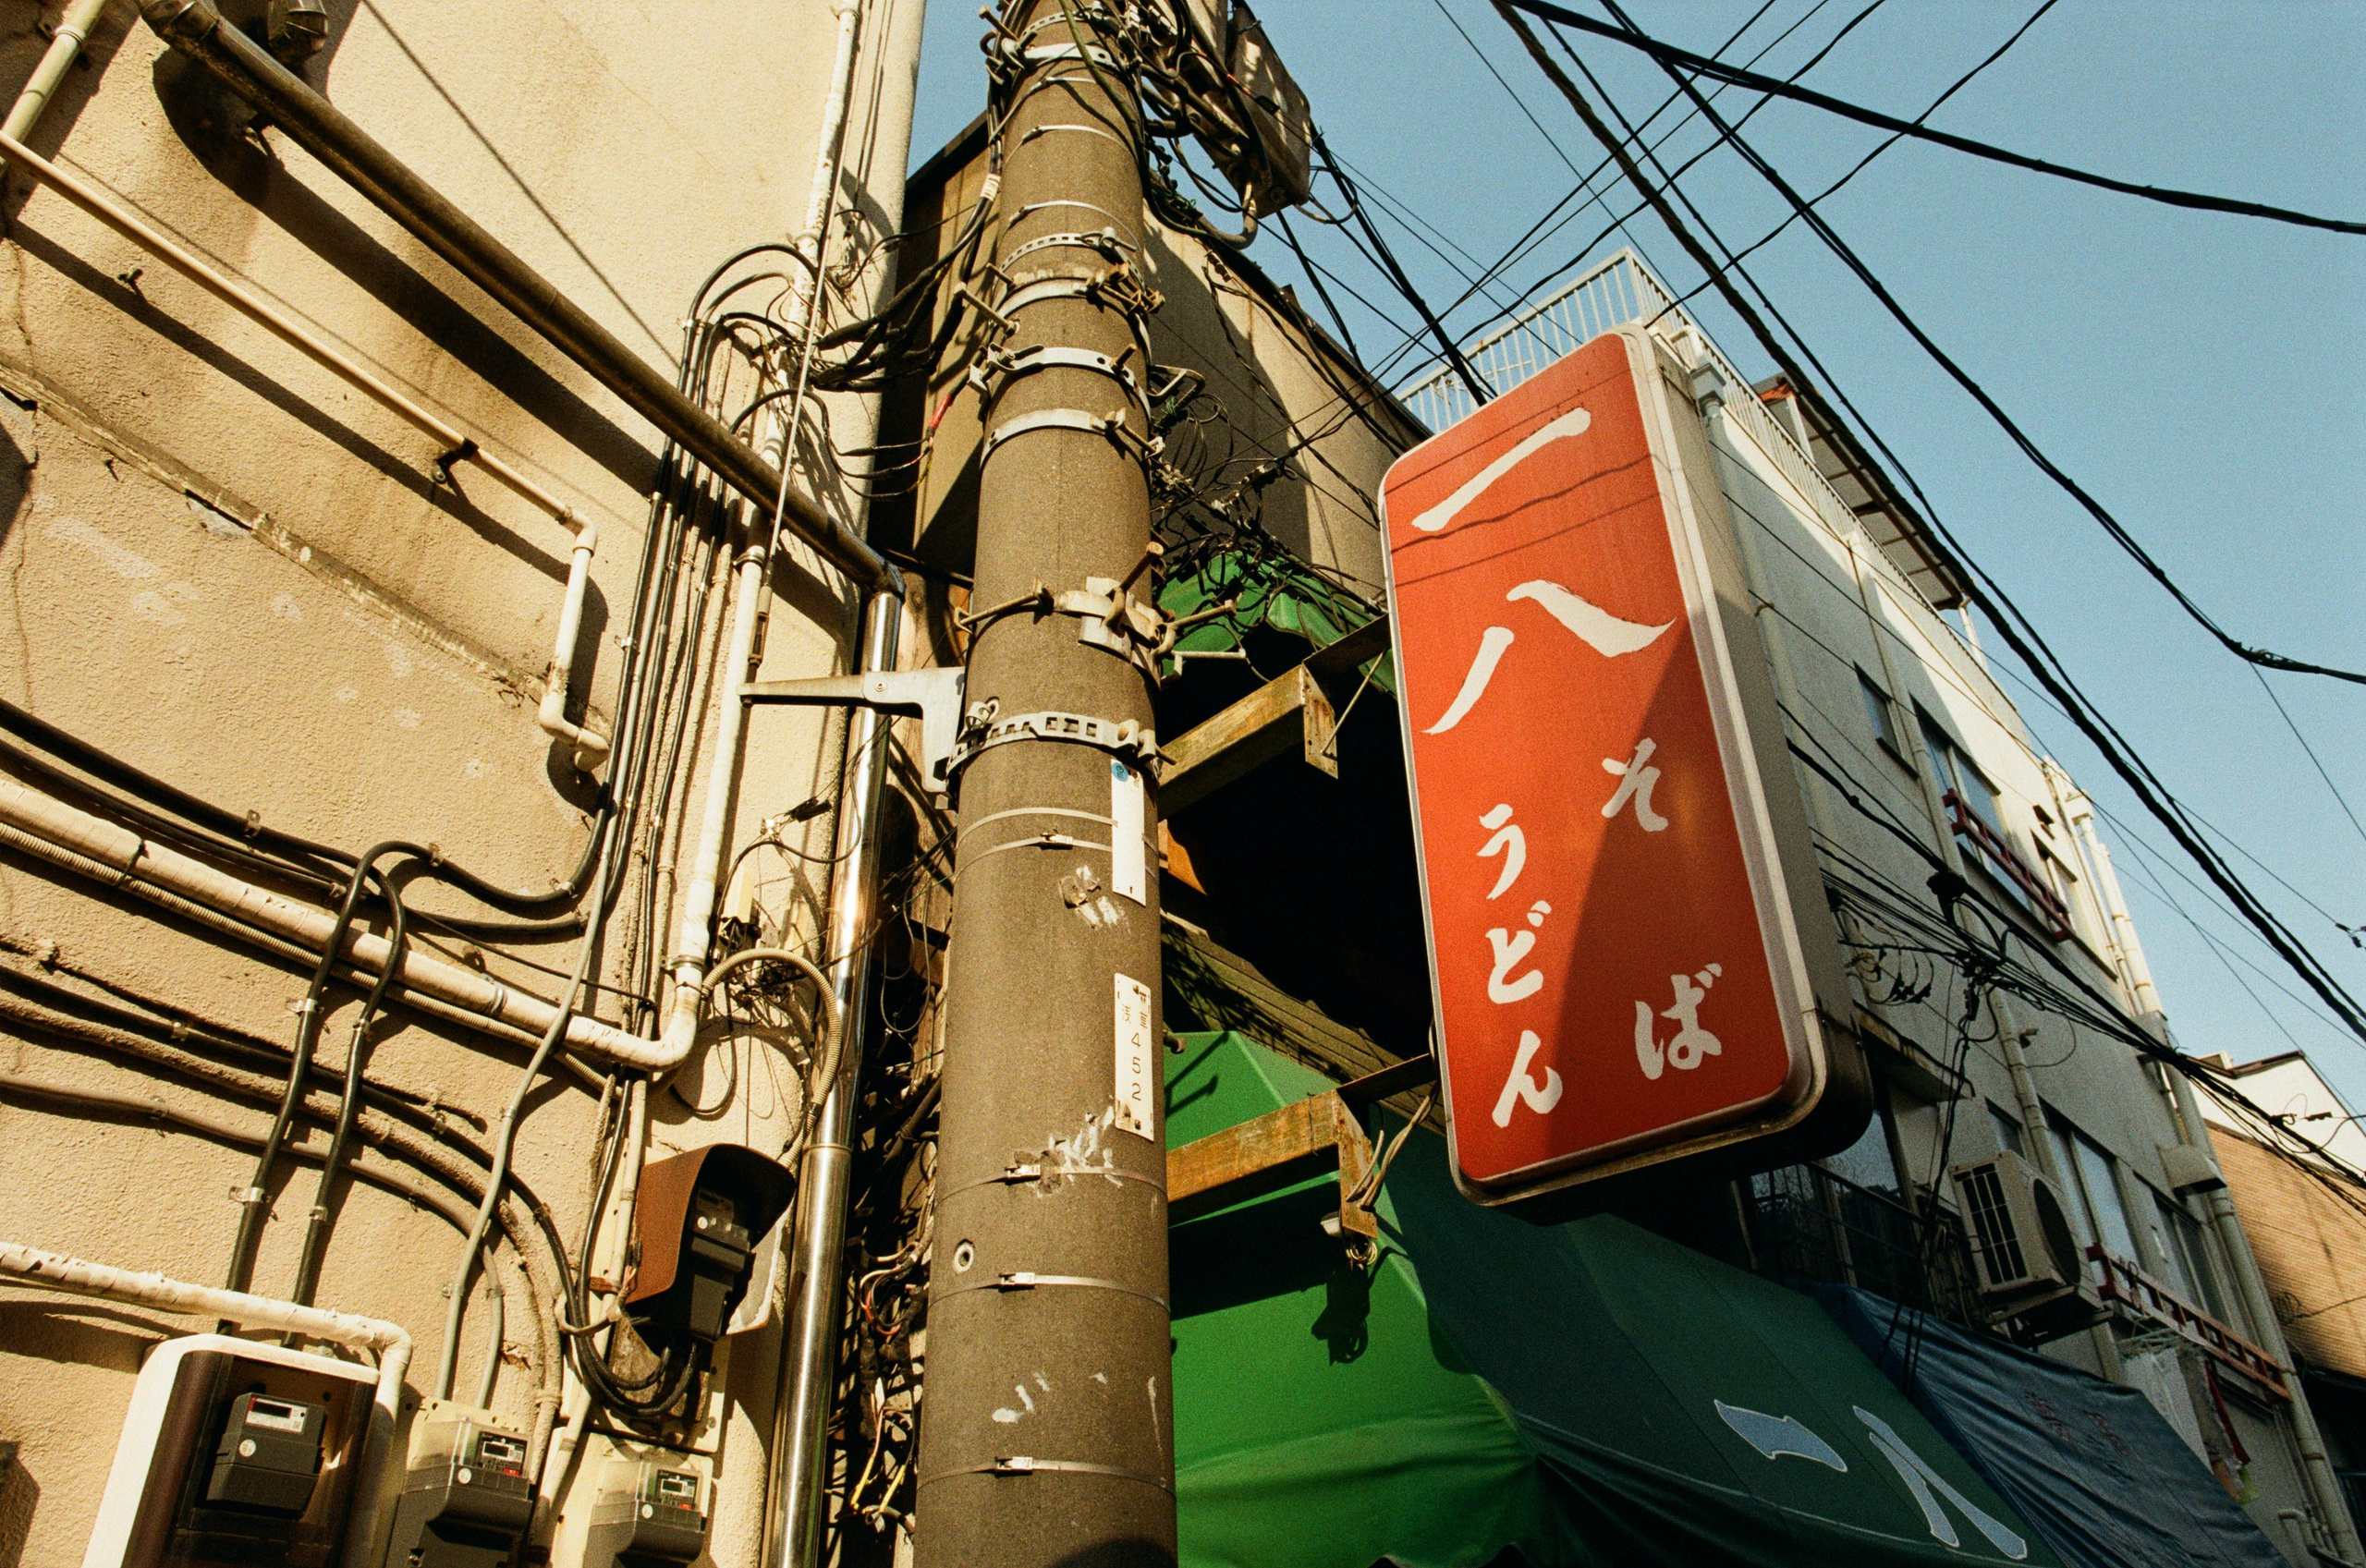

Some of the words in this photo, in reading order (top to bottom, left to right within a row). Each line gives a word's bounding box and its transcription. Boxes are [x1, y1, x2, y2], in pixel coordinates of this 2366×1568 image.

[1410, 407, 1677, 735] 一八
[1130, 1032, 1142, 1101] 452
[1476, 802, 1563, 1128] うどん
[1601, 737, 1723, 1079] そば
